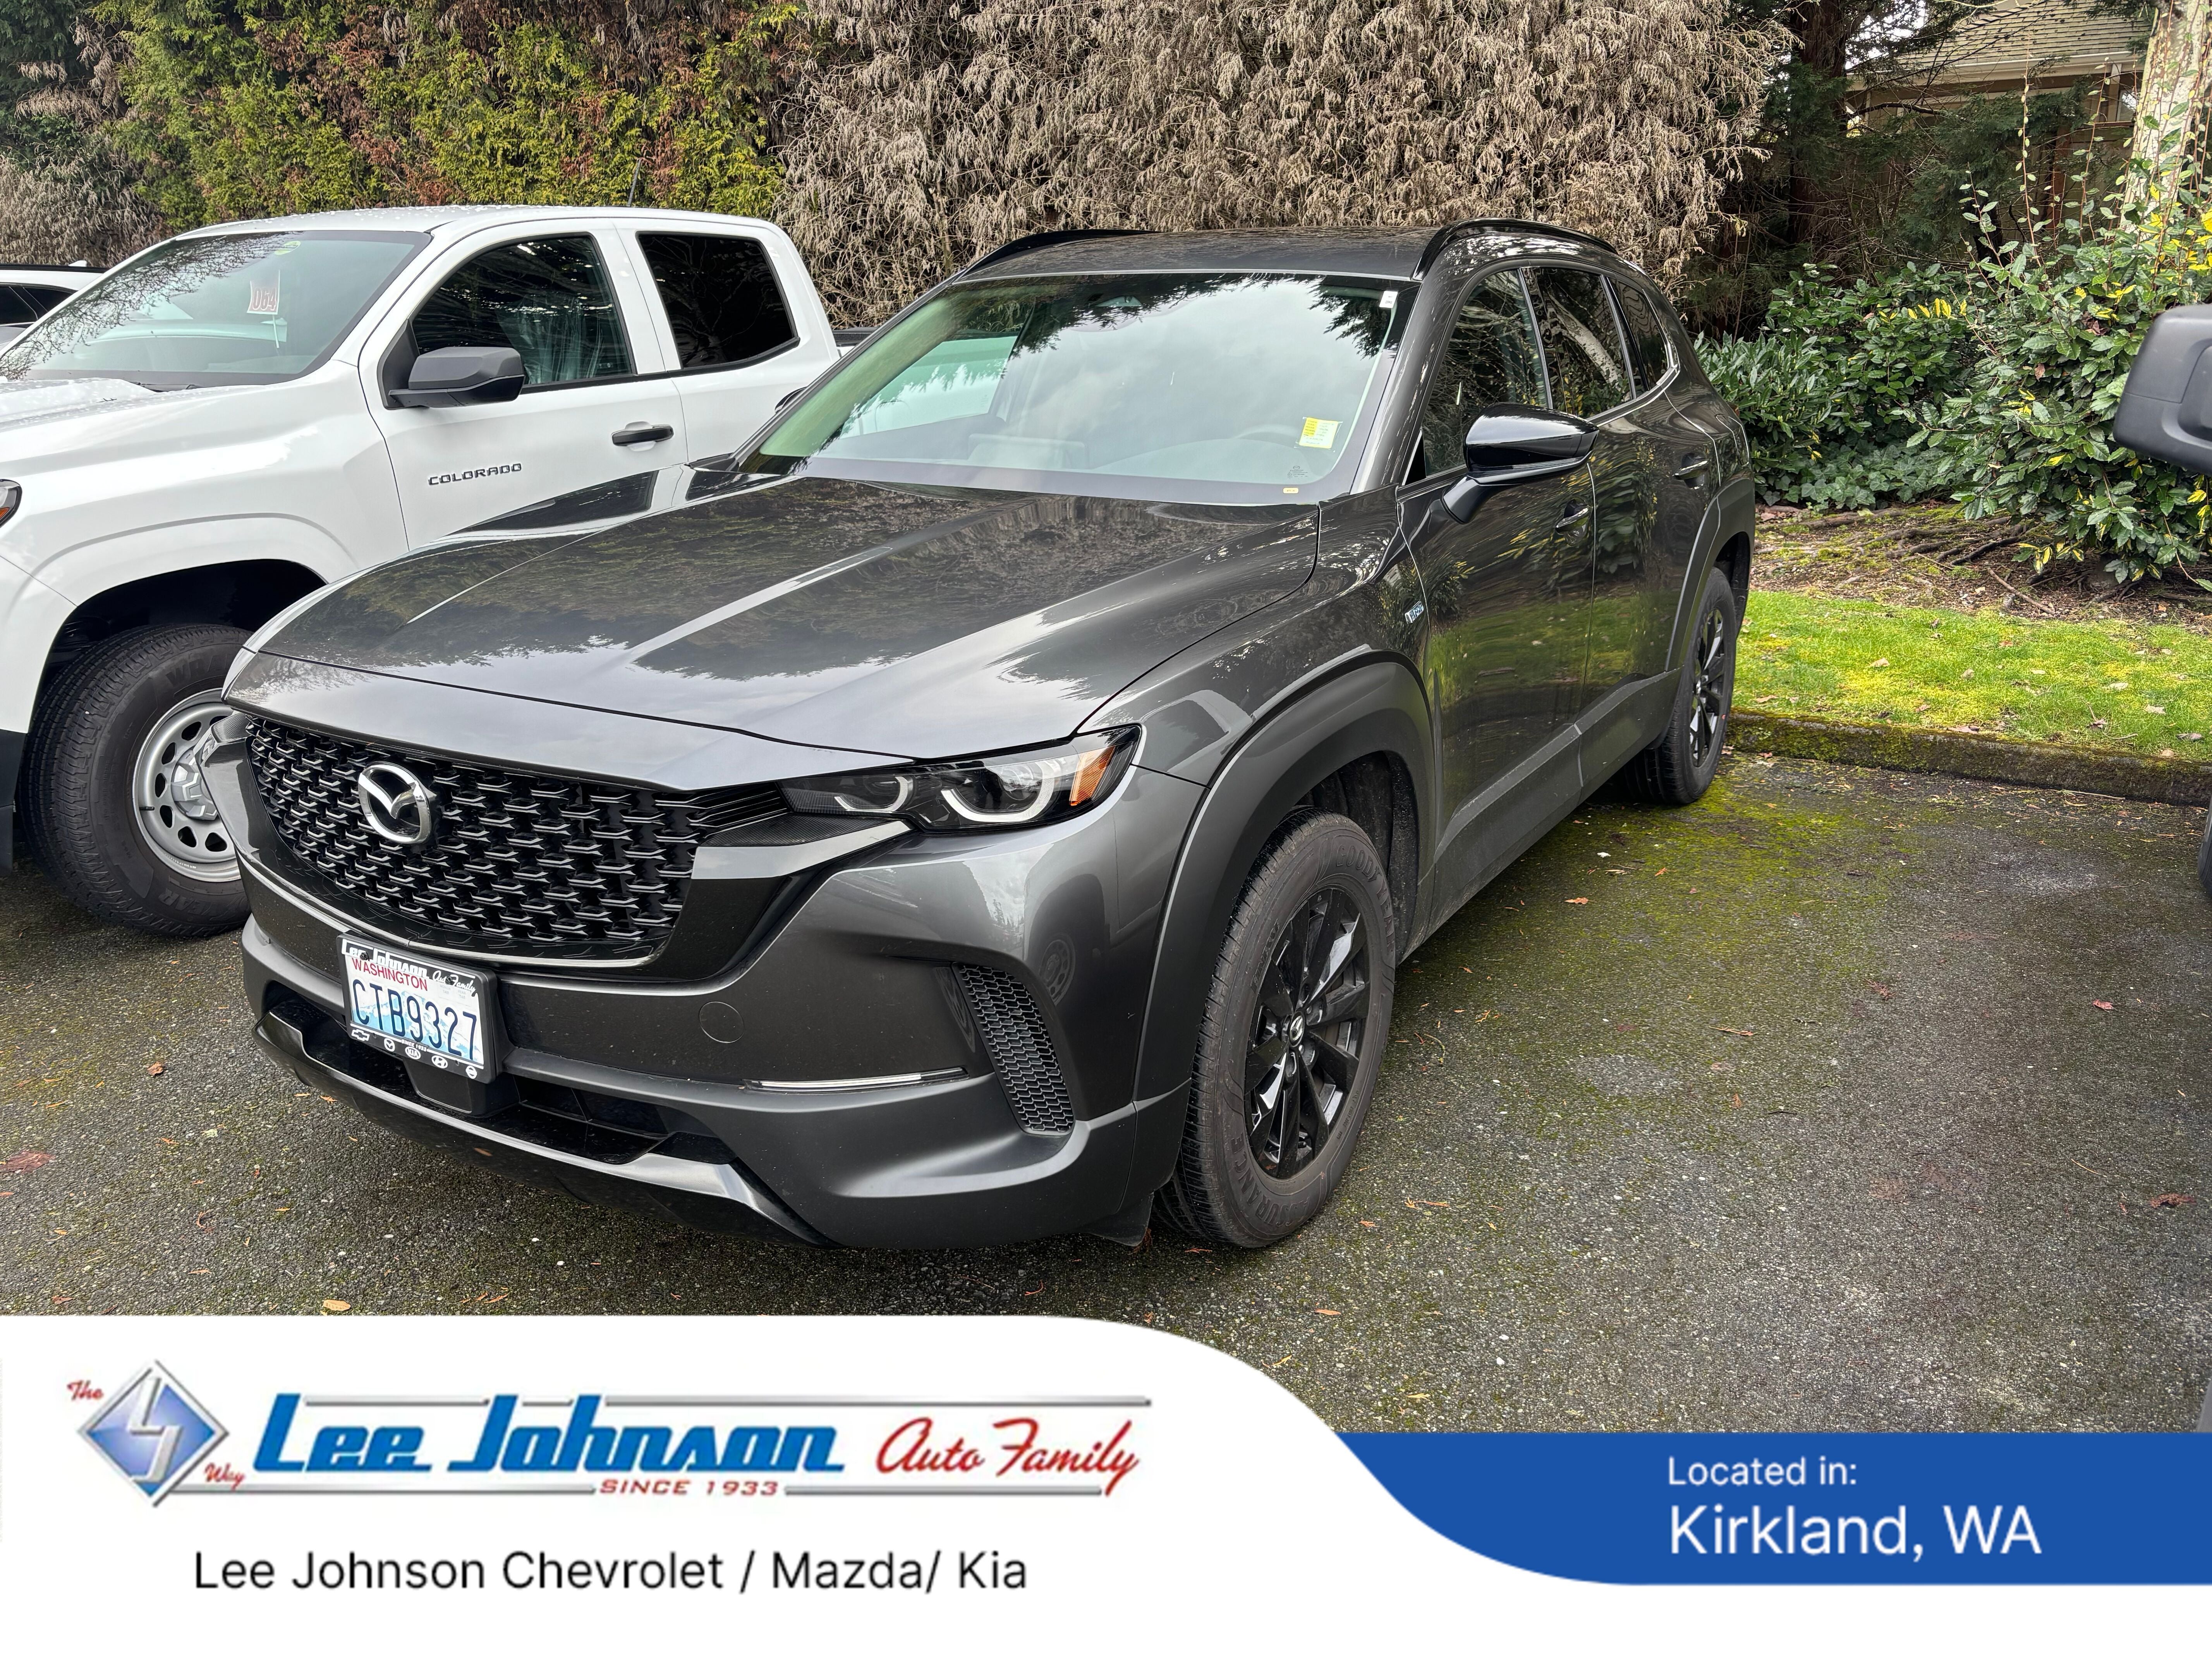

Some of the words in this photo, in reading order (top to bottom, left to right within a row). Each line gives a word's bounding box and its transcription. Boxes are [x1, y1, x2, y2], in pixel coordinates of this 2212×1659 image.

[428, 463, 522, 485] COLORADO
[352, 957, 428, 991] WASHINGTON
[369, 948, 429, 979] Johnson
[352, 979, 477, 1060] CTB9327
